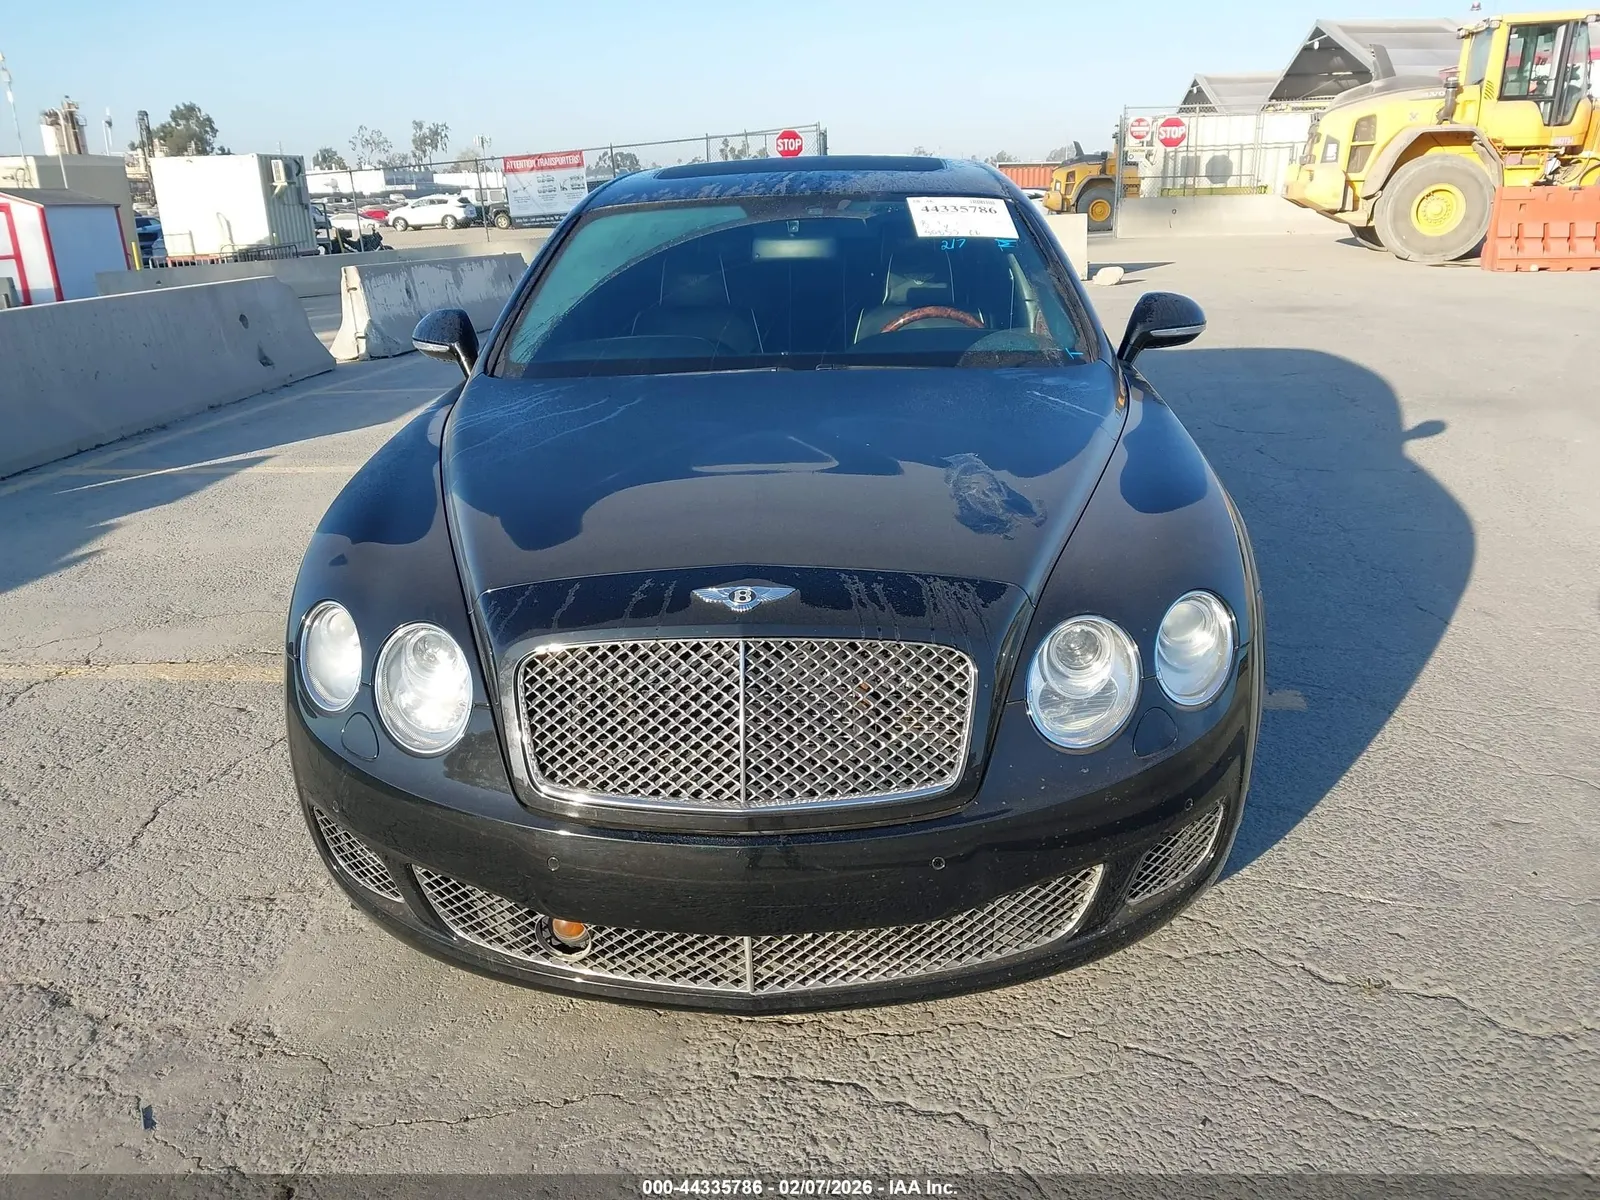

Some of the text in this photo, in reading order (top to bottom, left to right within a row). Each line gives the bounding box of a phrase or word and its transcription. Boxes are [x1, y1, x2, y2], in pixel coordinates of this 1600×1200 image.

[1159, 126, 1186, 140] STOP
[777, 138, 802, 151] STOP
[506, 158, 536, 170] ATTENTION
[921, 205, 998, 215] 44335786
[733, 589, 752, 603] B
